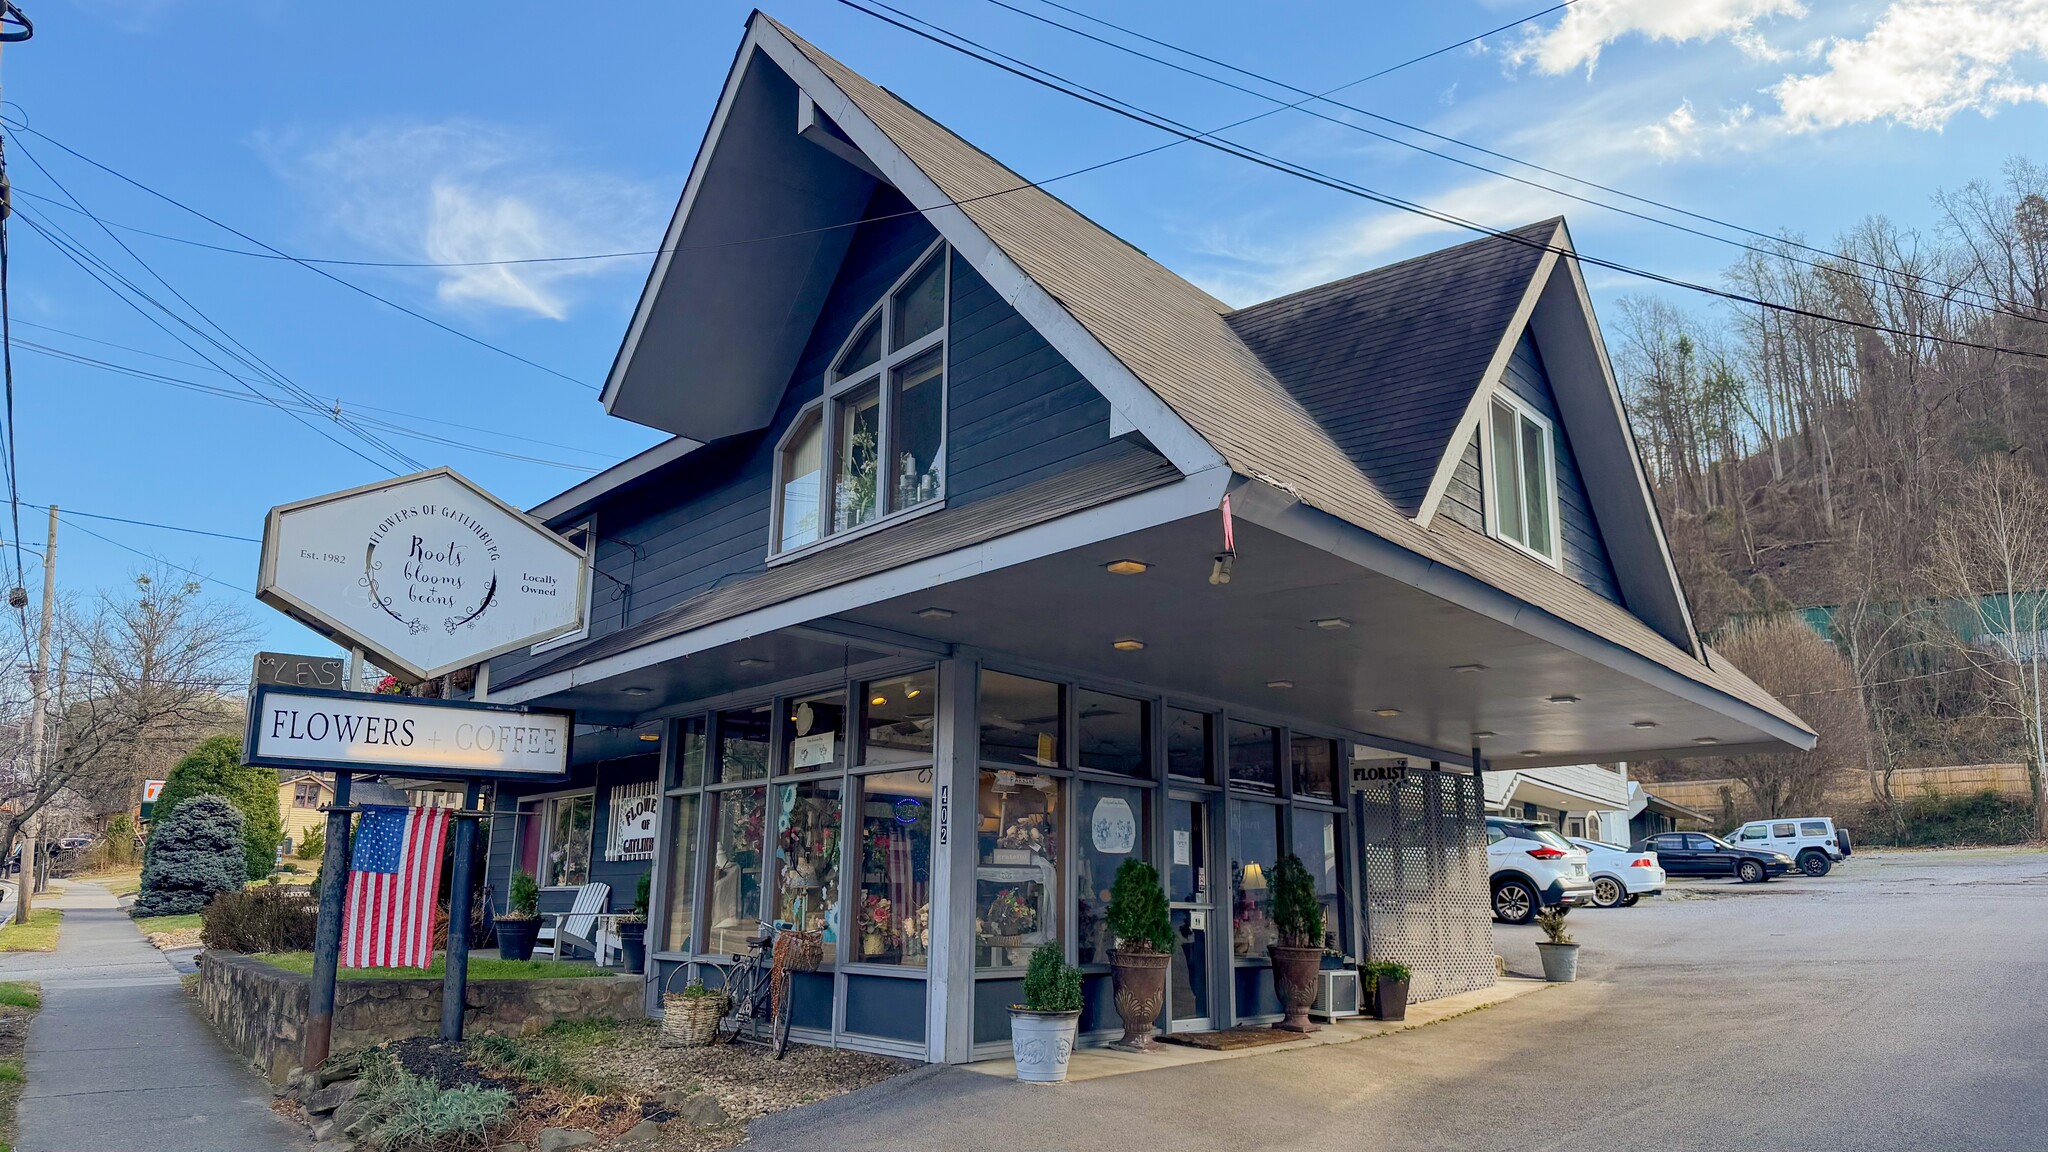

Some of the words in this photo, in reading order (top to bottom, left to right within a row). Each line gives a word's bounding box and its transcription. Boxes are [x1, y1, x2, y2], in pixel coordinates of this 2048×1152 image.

[369, 506, 418, 544] FLOWERS
[422, 504, 437, 515] OF
[441, 506, 501, 561] GATLINBURG
[300, 549, 319, 560] Est.
[323, 553, 346, 564] 1982
[408, 535, 468, 567] Roots
[404, 561, 465, 589] blooms
[523, 572, 557, 587] Locally
[408, 584, 456, 608] beans
[521, 584, 556, 597] Owned
[271, 709, 415, 747] FLOWERS
[455, 723, 557, 755] COFFEE
[1353, 766, 1406, 781] FLORIST
[625, 797, 657, 827] FLOWE
[641, 819, 650, 831] OF
[623, 837, 655, 854] GATLINB
